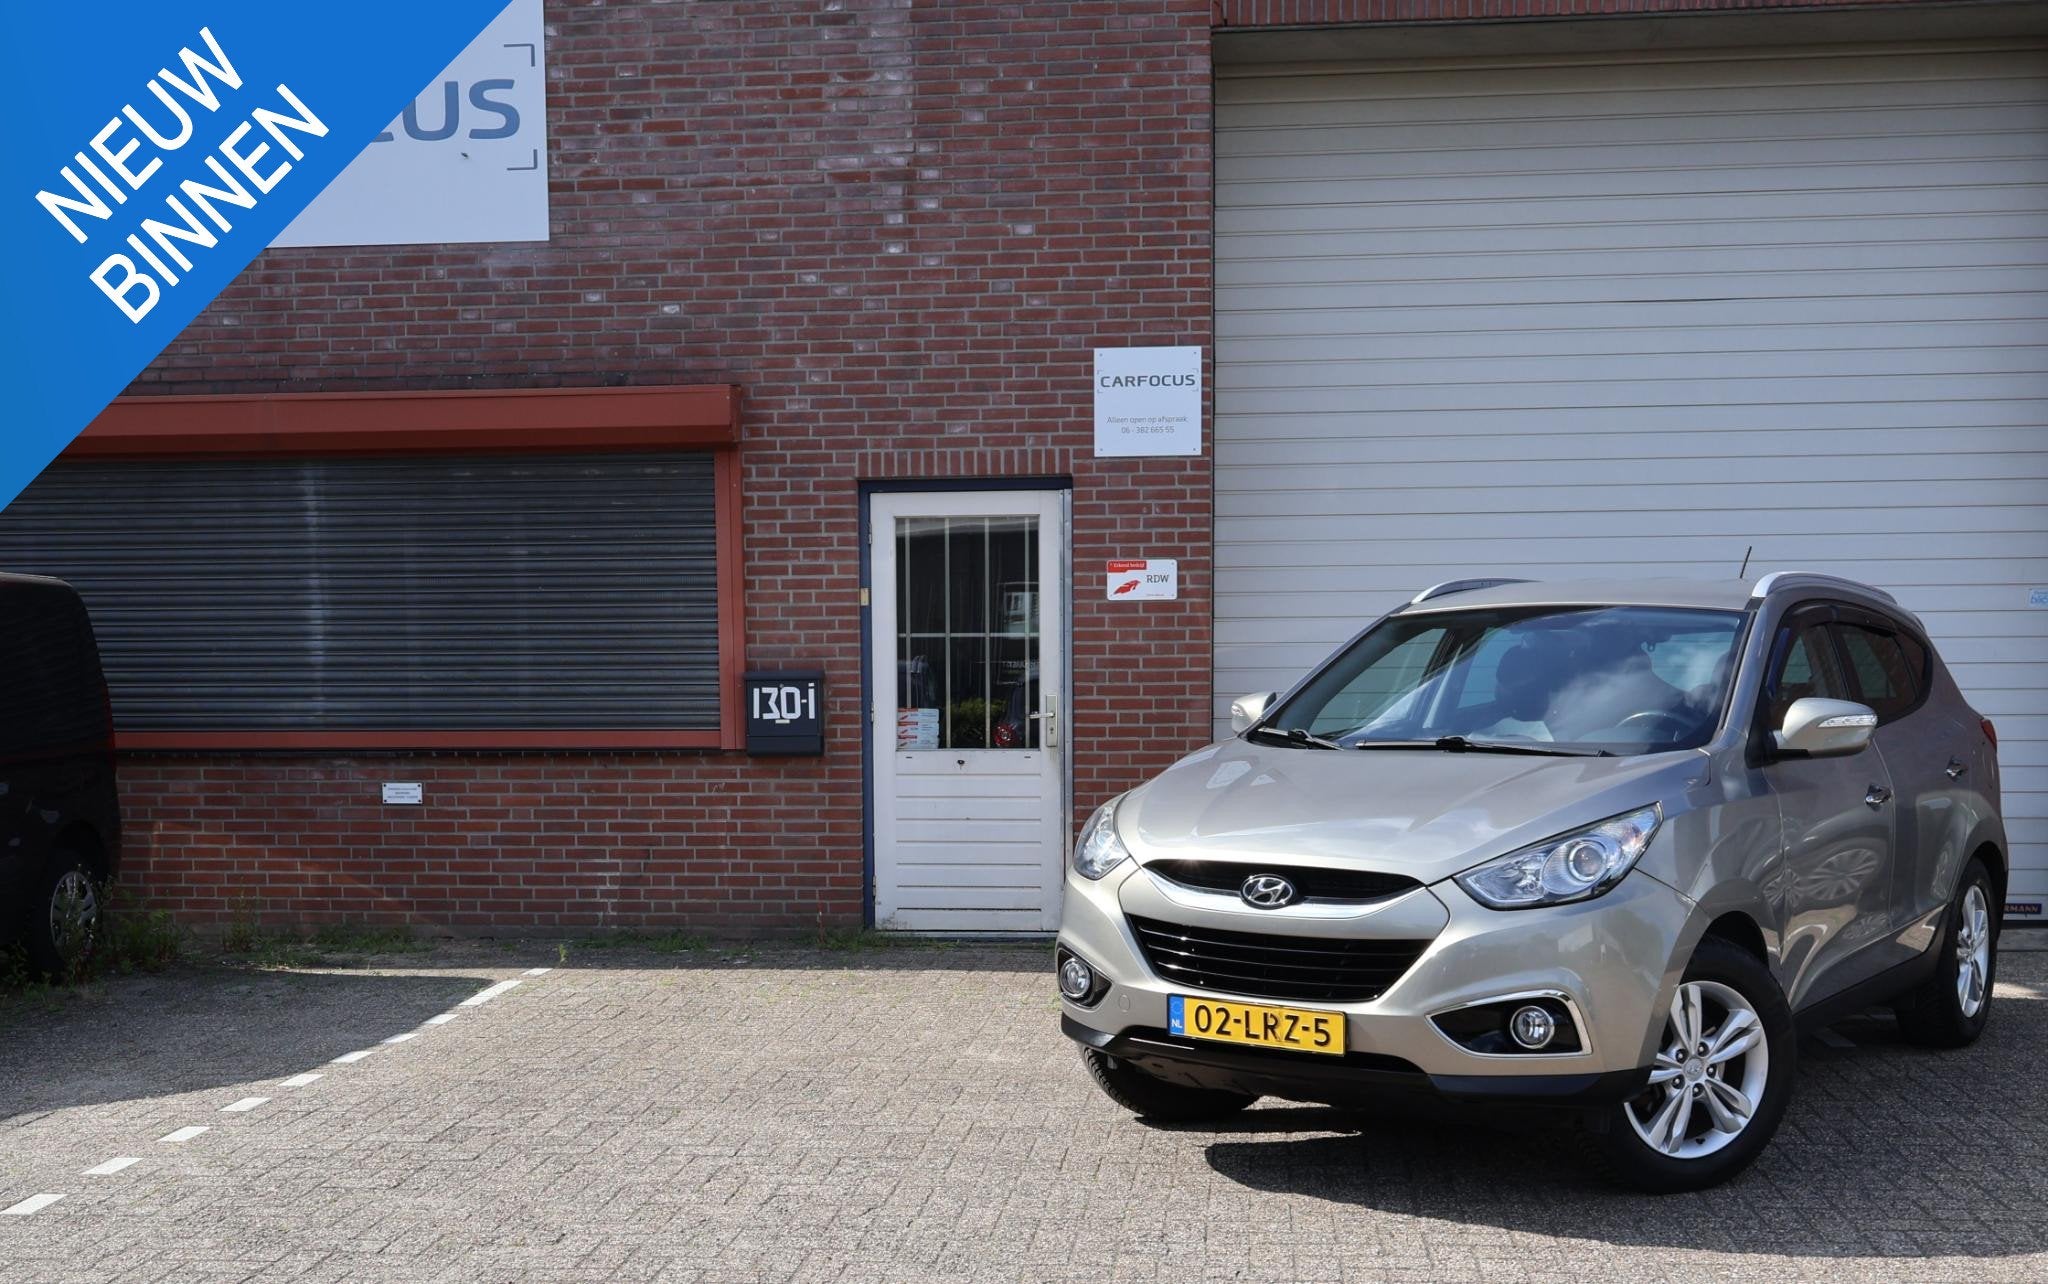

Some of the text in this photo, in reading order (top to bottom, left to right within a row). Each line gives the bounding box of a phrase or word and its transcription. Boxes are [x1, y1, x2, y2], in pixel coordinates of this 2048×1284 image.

[372, 79, 520, 142] US
[1100, 374, 1196, 388] CARFOCUS
[1107, 416, 1129, 424] Alleen
[1121, 426, 1131, 434] 06
[1146, 574, 1170, 583] RDW
[1171, 1018, 1183, 1029] NL
[1194, 1004, 1331, 1047] 02-LRZ-5
